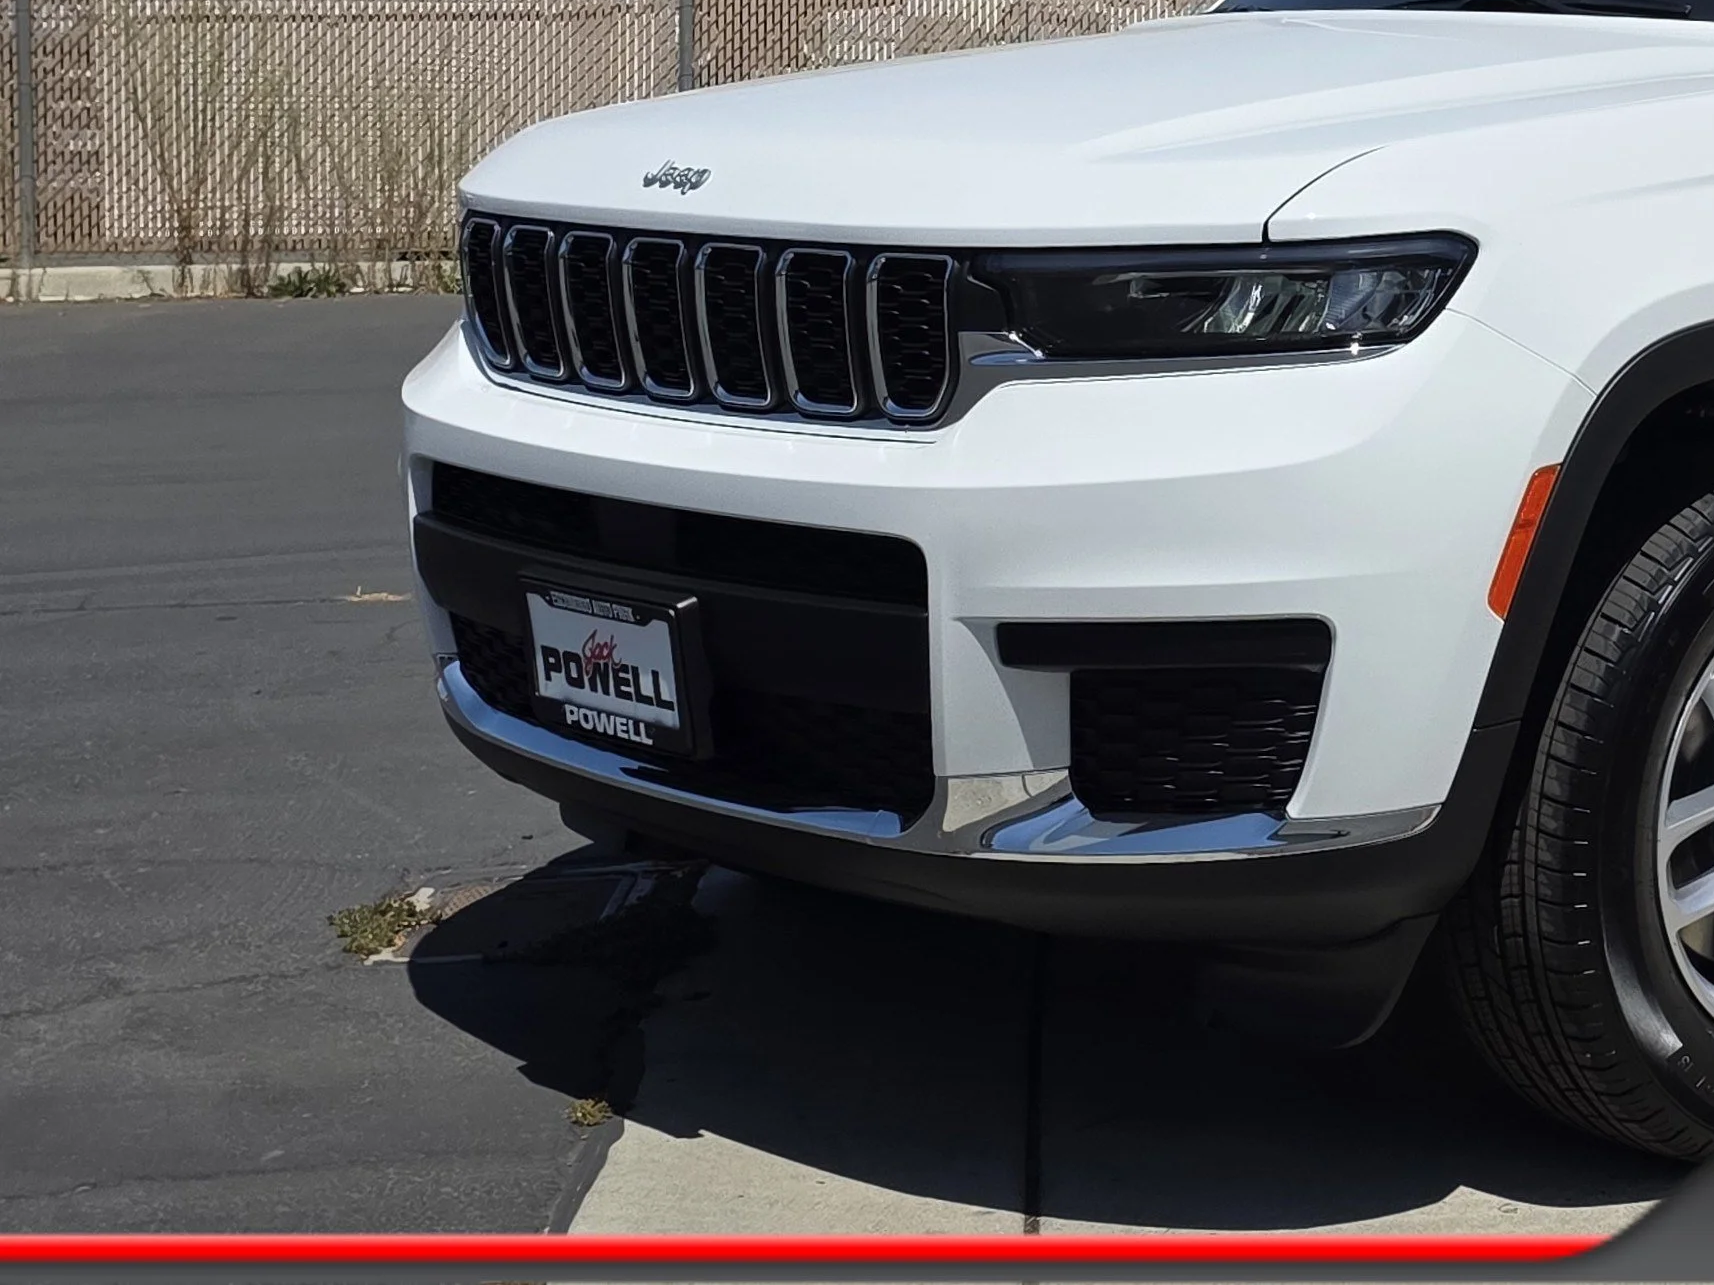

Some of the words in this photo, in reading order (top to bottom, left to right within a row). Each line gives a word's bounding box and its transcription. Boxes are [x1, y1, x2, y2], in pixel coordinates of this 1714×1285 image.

[642, 158, 712, 196] Jeep
[582, 628, 622, 678] Jack
[540, 644, 676, 712] POWELL
[564, 703, 654, 746] POWELL
